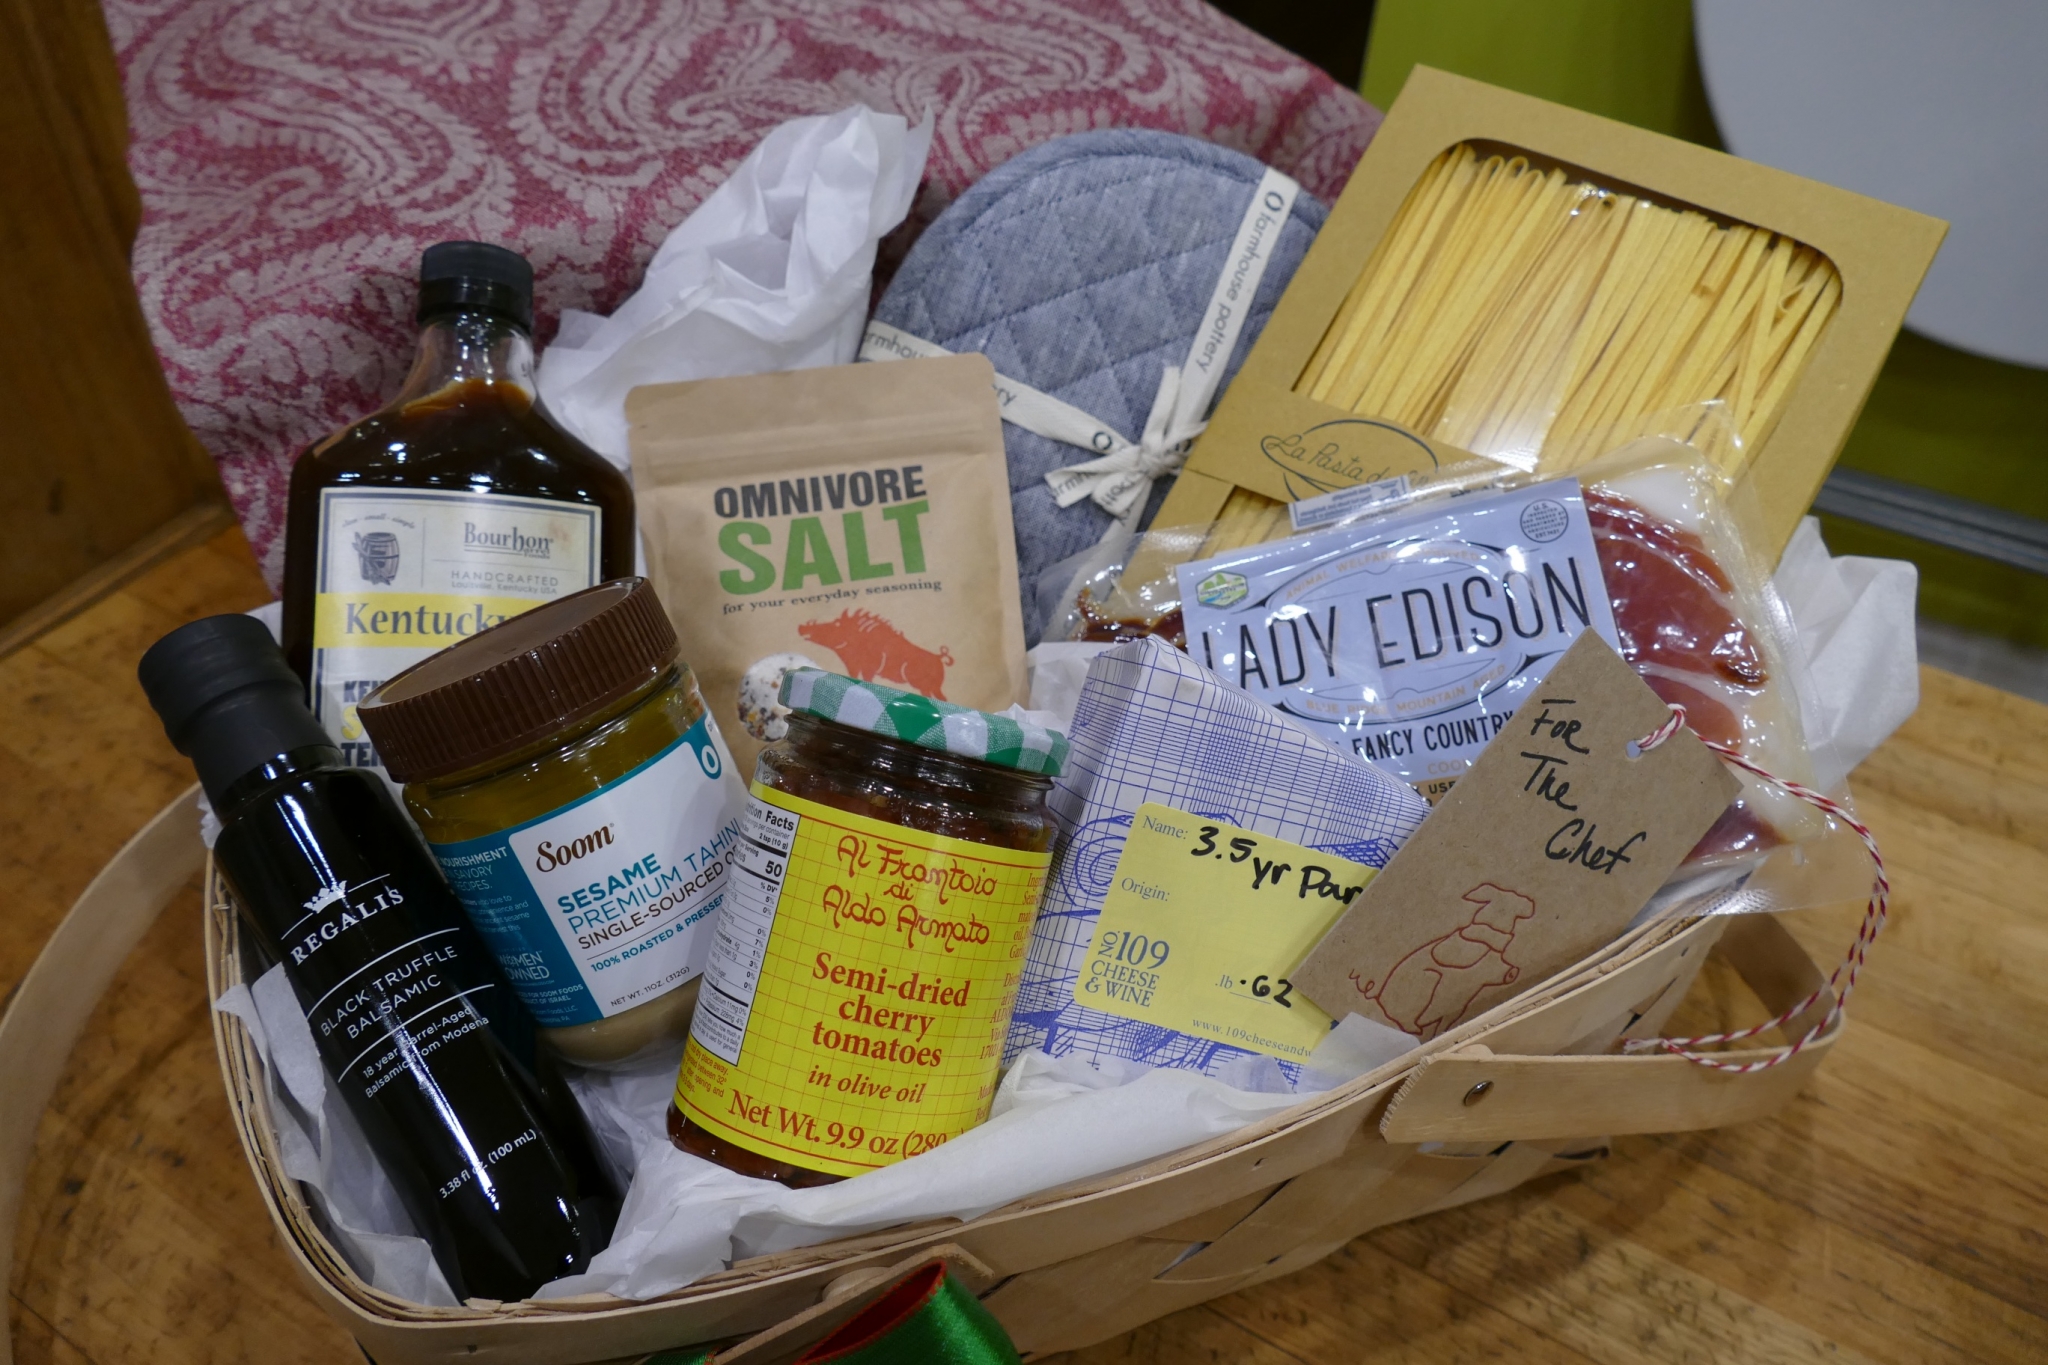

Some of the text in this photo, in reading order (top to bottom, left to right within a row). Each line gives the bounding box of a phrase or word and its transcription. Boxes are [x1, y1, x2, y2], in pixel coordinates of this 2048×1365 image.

[1197, 212, 1280, 374] farmhouse pottery
[1265, 434, 1363, 482] La Pasta
[713, 465, 927, 518] OMNIVORE
[718, 500, 930, 595] SALT
[451, 569, 559, 587] HANDCRAFTED
[497, 583, 539, 594] Kentucky
[541, 586, 557, 595] USA
[722, 579, 942, 615] for your everyday seasoning
[1285, 551, 1393, 600] ANIMAL WELFAR
[1202, 555, 1591, 691] LADY EDISON
[1306, 700, 1339, 713] BLUE
[1397, 686, 1466, 712] MOUNTAIN
[1472, 665, 1506, 689] AGED
[1352, 729, 1413, 760] FANCY
[765, 810, 795, 831] Facts
[765, 826, 790, 840] container
[771, 838, 781, 846] (10
[1142, 815, 1189, 840] Name:
[441, 846, 508, 868] NOURISHMENT
[536, 824, 613, 873] Soom
[765, 860, 782, 878] 50
[1190, 826, 1257, 863] 3.5
[1252, 857, 1291, 890] yr
[1545, 818, 1648, 875] Chef
[454, 865, 493, 880] SAVORY
[557, 853, 662, 914] SESAME
[876, 843, 998, 905] Frantoio
[883, 884, 915, 902] di
[1121, 877, 1170, 901] Origin:
[515, 900, 529, 911] and
[567, 866, 683, 934] PREMIUM
[578, 859, 723, 949] SINGLE-SOURCED
[822, 884, 990, 953] Aldo Armato
[290, 888, 404, 965] REGALIS
[591, 955, 621, 972] 100%
[622, 928, 675, 961] ROASTED
[675, 922, 685, 933] &
[504, 965, 550, 980] OWNED
[1115, 931, 1170, 970] 109
[320, 946, 458, 1037] BLACK TRUFFLE
[558, 984, 584, 994] FOODS
[610, 995, 626, 1007] NET
[627, 988, 642, 1002] WT.
[665, 966, 691, 984] (312G)
[813, 951, 972, 1007] Semi-dried
[1085, 976, 1154, 1007] & WINE
[1091, 959, 1160, 990] CHEESE
[346, 974, 442, 1040] BALSAMIC
[548, 995, 572, 1004] ISRAEL
[838, 995, 936, 1042] cherry
[362, 1006, 473, 1079] 18 year Barrel-Aged
[364, 1015, 490, 1098] Balsamic from Modena
[812, 1021, 943, 1067] tomatoes
[713, 1062, 728, 1075] away.
[808, 1065, 927, 1104] in olive oil
[713, 1086, 724, 1098] and
[729, 1089, 772, 1127] Net
[778, 1106, 820, 1143] Wt.
[827, 1122, 865, 1150] 9.9
[868, 1135, 899, 1157] oz
[439, 1178, 461, 1199] 3.38
[460, 1169, 471, 1182] fl
[487, 1143, 513, 1164] (100
[510, 1128, 538, 1153] mL)
